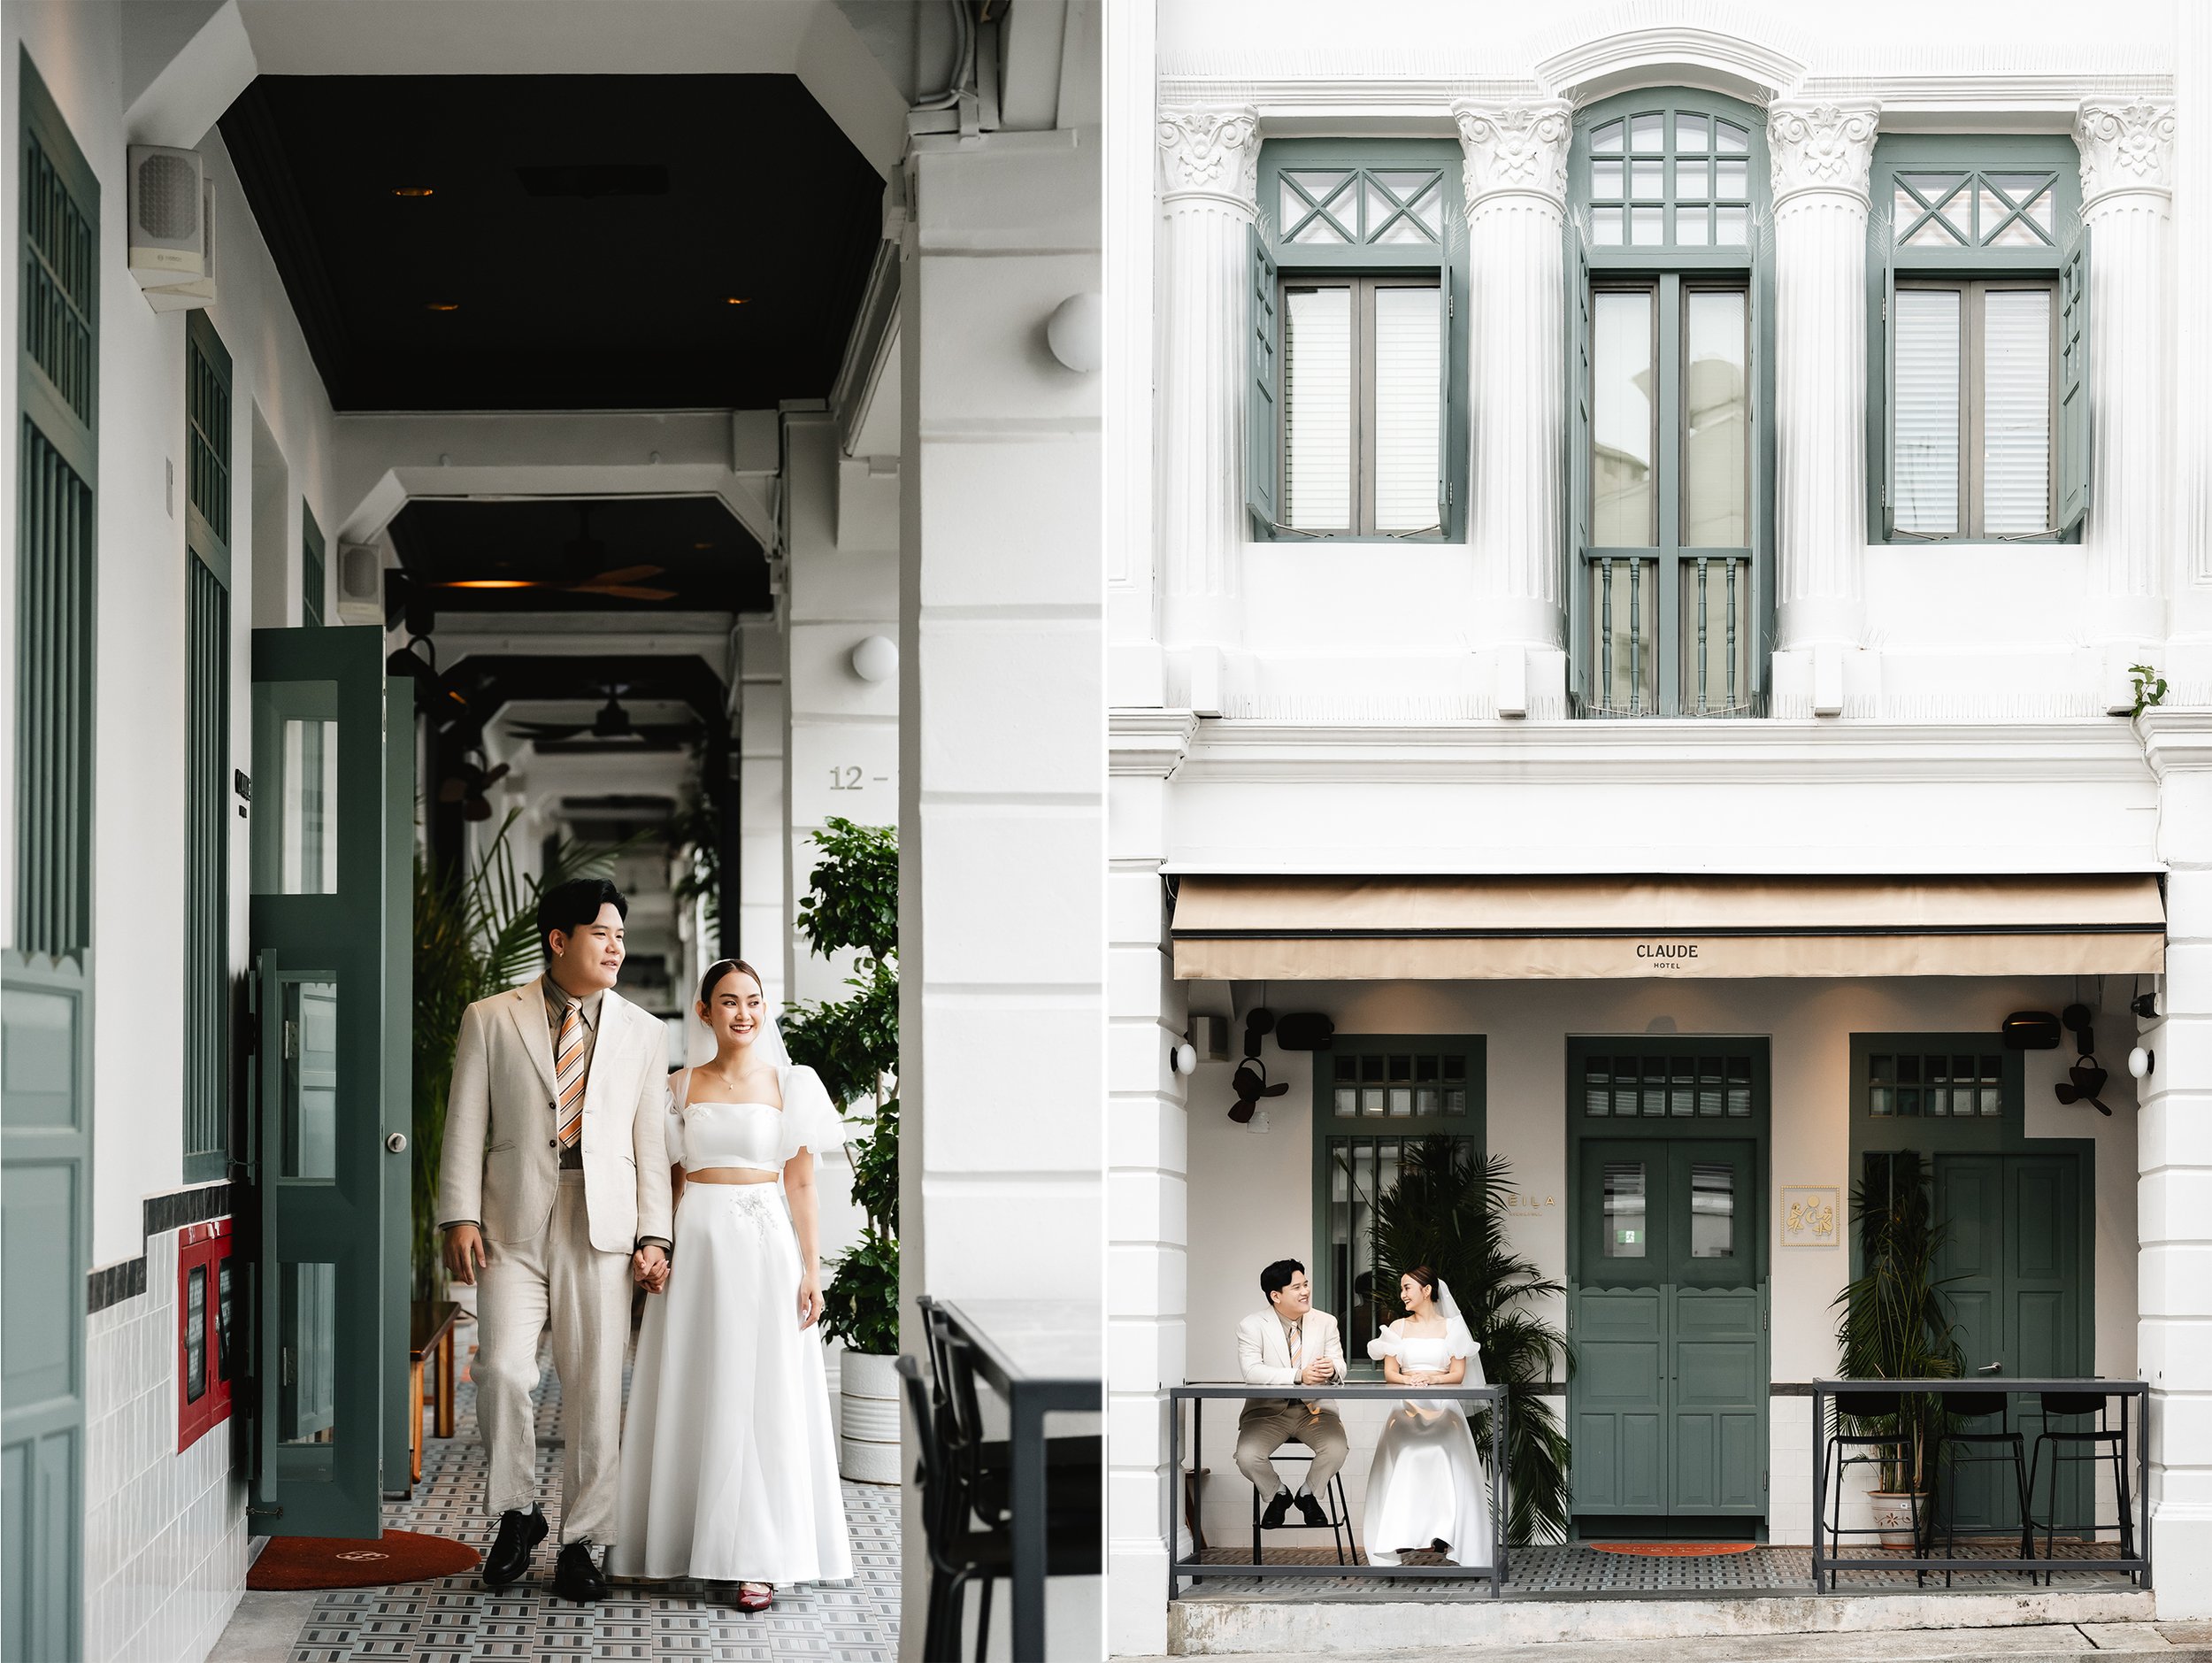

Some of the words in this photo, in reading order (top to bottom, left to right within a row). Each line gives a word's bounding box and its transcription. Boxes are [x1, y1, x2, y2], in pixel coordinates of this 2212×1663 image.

[829, 766, 863, 789] 12
[1636, 944, 1698, 958] CLAUDE
[1495, 1194, 1555, 1208] EILA
